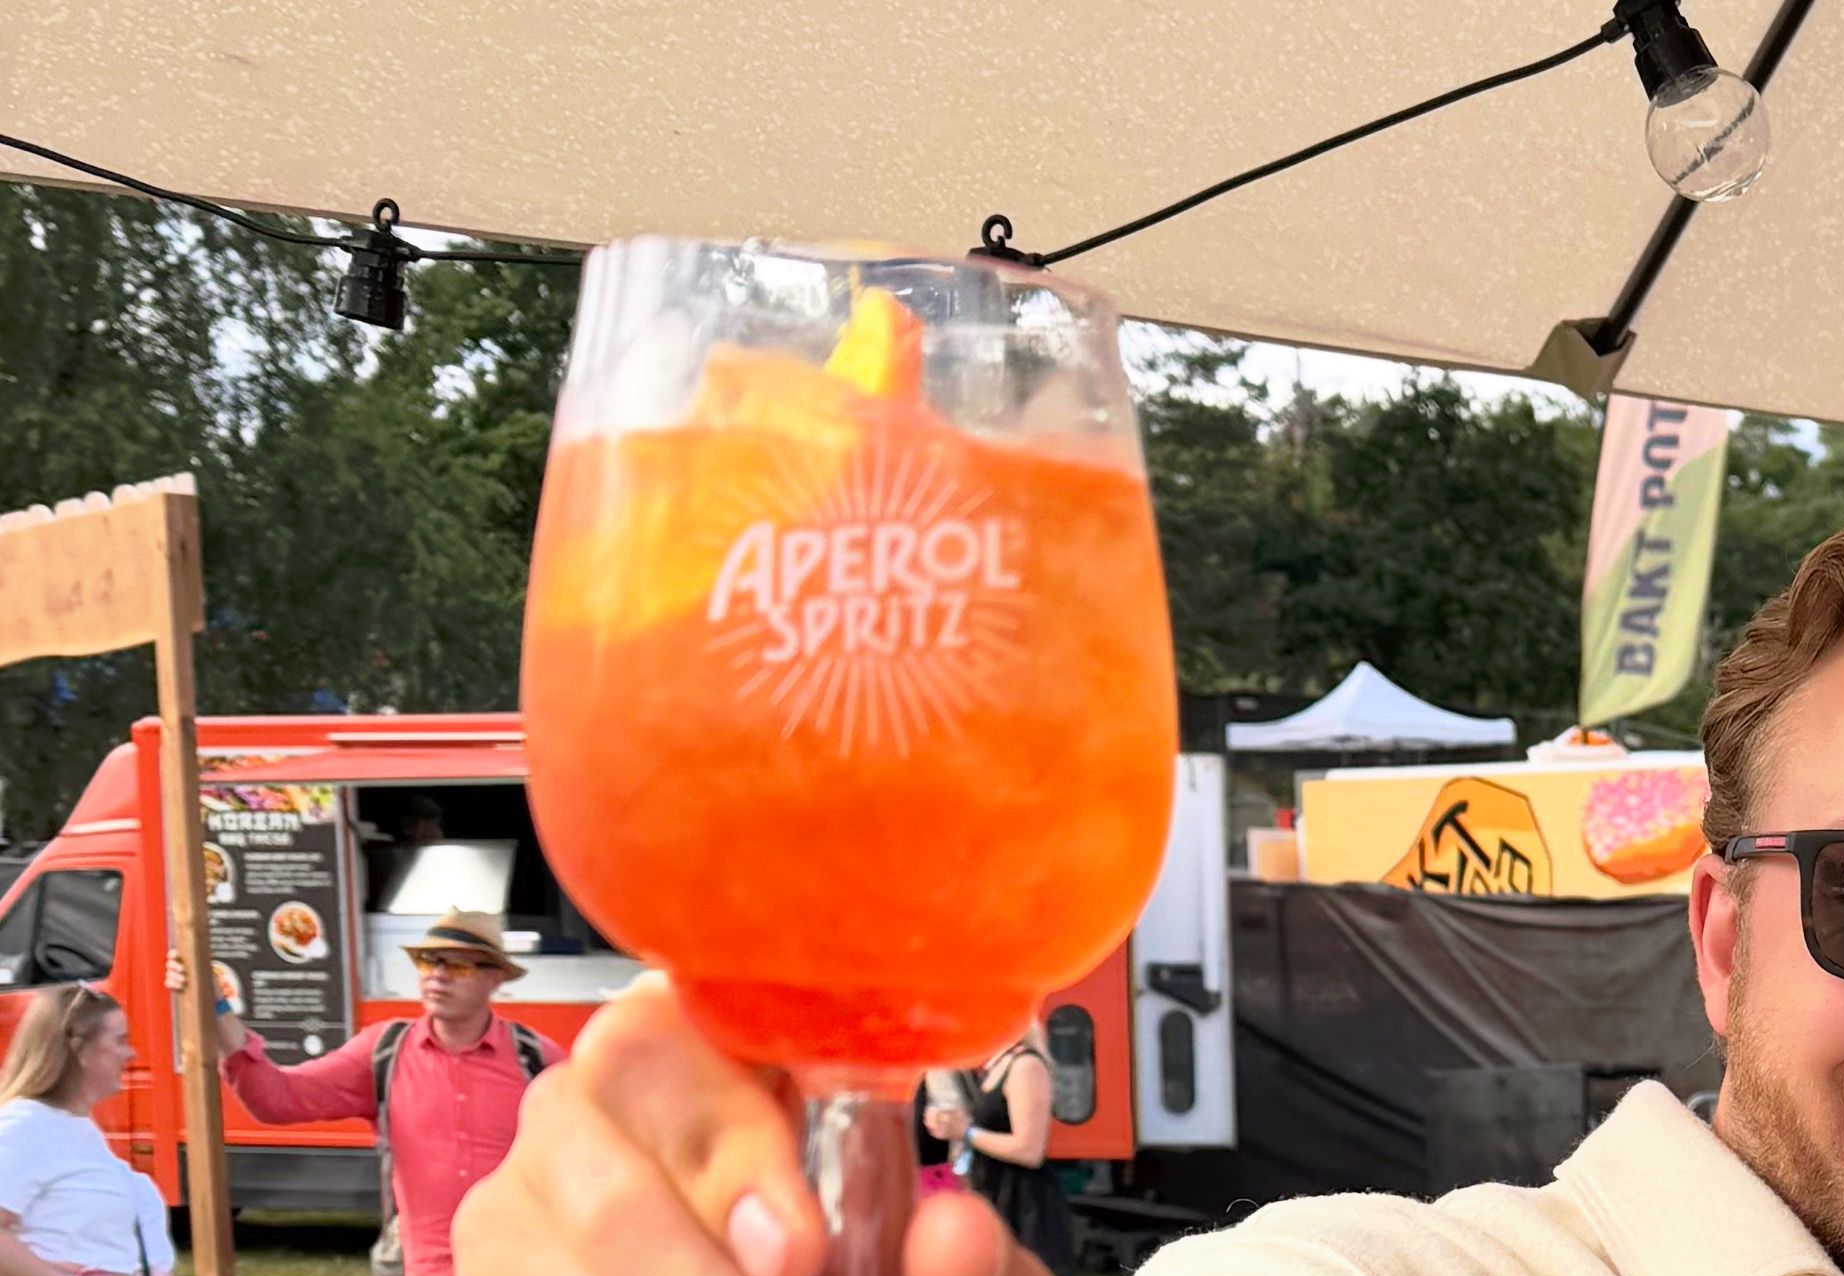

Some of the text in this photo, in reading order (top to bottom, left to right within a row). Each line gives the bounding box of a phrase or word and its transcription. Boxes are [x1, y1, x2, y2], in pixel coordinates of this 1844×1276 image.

[706, 520, 1022, 622] APEROL
[1614, 529, 1673, 677] BAKT
[761, 594, 971, 662] SPRITZ
[207, 812, 301, 831] KOREAN
